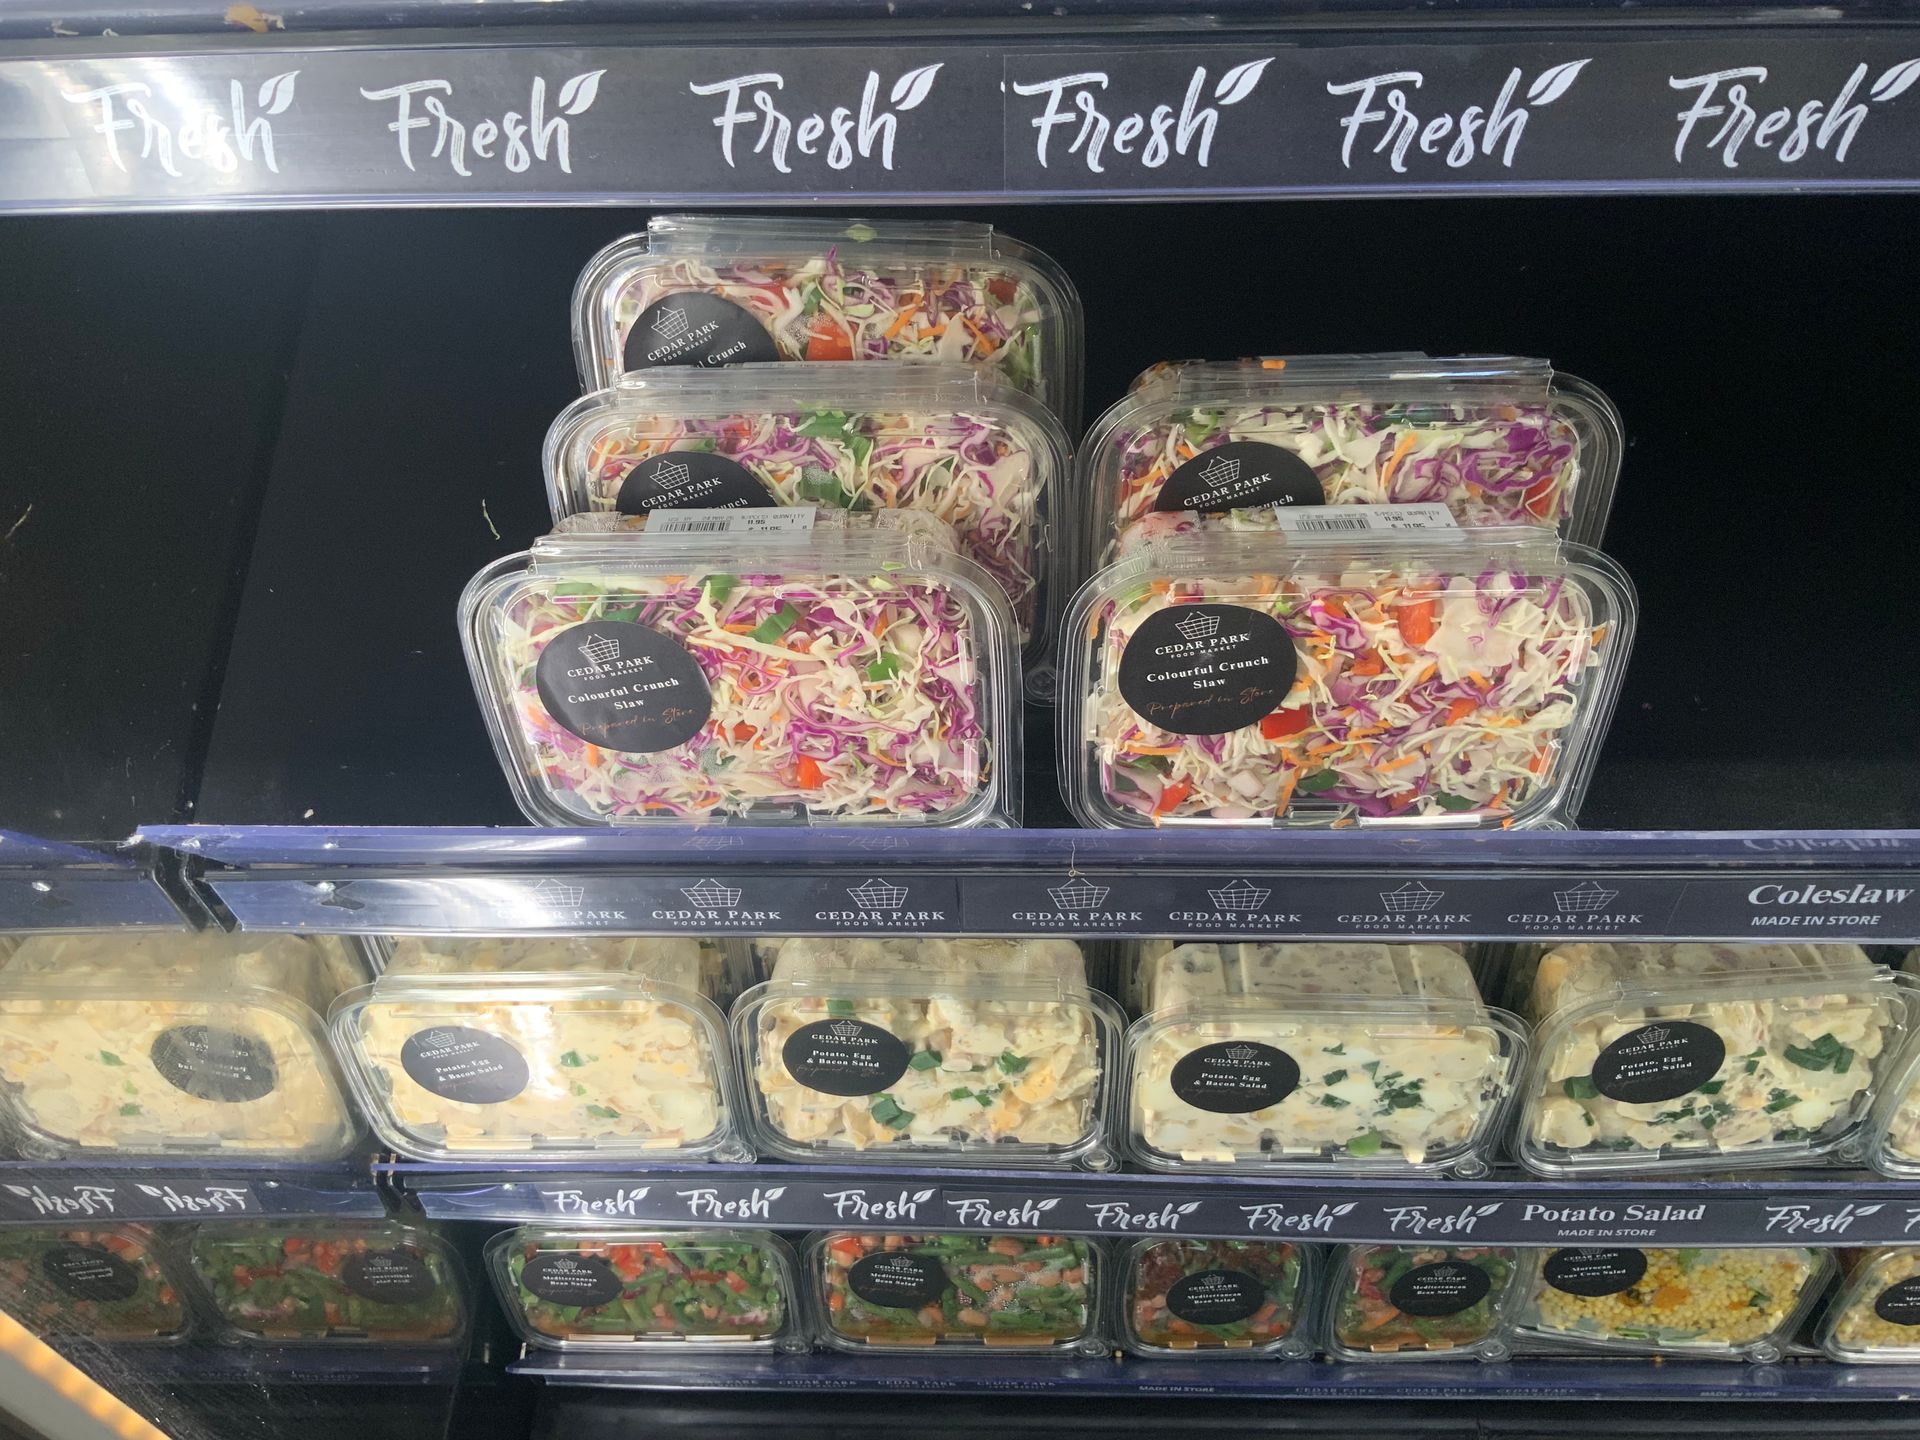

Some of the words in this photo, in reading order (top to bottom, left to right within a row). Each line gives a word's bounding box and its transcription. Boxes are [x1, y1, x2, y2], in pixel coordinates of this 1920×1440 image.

[689, 70, 895, 174] Fresh
[1014, 66, 1218, 173] Fresh
[1327, 67, 1531, 173] Fresh
[1669, 63, 1868, 168] Fresh
[61, 79, 281, 174] Fresh
[361, 76, 572, 177] Fresh
[647, 338, 686, 362] CEDAR
[687, 320, 719, 342] PARK
[663, 351, 682, 363] FOOD
[684, 334, 713, 352] MARKET
[707, 340, 747, 365] Crunch
[641, 488, 685, 508] CEDAR
[687, 477, 722, 493] PARK
[658, 501, 679, 509] FOOD
[683, 488, 713, 502] MARKET
[1183, 486, 1230, 507] CEDAR
[1234, 473, 1272, 491] PARK
[1199, 499, 1222, 508] FOOD
[1226, 486, 1260, 500] MARKET
[707, 497, 749, 510] unch
[1249, 494, 1294, 510] unch
[1155, 640, 1204, 656] CEDAR
[1210, 632, 1250, 646] PARK
[1200, 644, 1237, 654] MARKET
[567, 663, 613, 678] CEDAR
[616, 655, 654, 669] PARK
[610, 667, 644, 677] MARKET
[1146, 664, 1213, 683] Colourful
[1219, 656, 1269, 672] Crunch
[567, 686, 630, 704] Colourful
[633, 677, 680, 693] Crunch
[1193, 678, 1226, 690] Slaw
[613, 699, 645, 710] Slaw
[1147, 694, 1214, 719] Prepared
[1240, 686, 1274, 705] Store
[1748, 883, 1915, 905] Coleslaw
[573, 910, 627, 920] PARK
[652, 910, 720, 919] CEDAR
[728, 910, 782, 920] PARK
[815, 911, 883, 920] CEDAR
[892, 911, 945, 920] PARK
[1012, 912, 1080, 920] CEDAR
[1090, 911, 1143, 920] PARK
[1168, 911, 1238, 921] CEDAR
[1247, 913, 1302, 922] PARK
[1337, 914, 1406, 923] CEDAR
[1416, 913, 1472, 923] PARK
[1507, 914, 1577, 923] CEDAR
[1587, 914, 1644, 923] PARK
[1751, 915, 1801, 926] MADE
[1802, 915, 1825, 926] IN
[1826, 915, 1882, 926] STORE
[811, 1033, 847, 1042] CEDAR
[1618, 1044, 1655, 1055] CEDAR
[1659, 1037, 1689, 1047] PARK
[420, 1047, 452, 1059] CEDAR
[454, 1040, 480, 1050] PARK
[812, 1050, 849, 1058] Potato,
[853, 1052, 872, 1060] Egg
[435, 1063, 471, 1073] Potato,
[819, 1058, 849, 1066] Bacon
[852, 1060, 880, 1068] Salad
[1204, 1057, 1239, 1065] CEDAR
[1620, 1060, 1659, 1071] Potato,
[1628, 1067, 1659, 1077] Bacon
[1662, 1061, 1692, 1071] Salad
[448, 1070, 476, 1080] Bacon
[477, 1064, 504, 1073] Salad
[1201, 1072, 1238, 1080] Potato,
[1241, 1074, 1261, 1082] Egg
[1238, 1081, 1267, 1089] Salad
[542, 1187, 637, 1216] Fresh
[676, 1186, 770, 1218] Fresh
[824, 1188, 918, 1219] Fresh
[947, 1197, 1040, 1226] Fresh
[1086, 1202, 1180, 1230] Fresh
[1240, 1204, 1334, 1233] Fresh
[1384, 1204, 1478, 1234] Fresh
[1520, 1204, 1616, 1222] Potato
[1623, 1203, 1706, 1221] Salad
[1766, 1203, 1854, 1234] Fresh
[1557, 1229, 1595, 1237] MADE
[1596, 1229, 1613, 1237] IN
[1615, 1229, 1657, 1237] STORE
